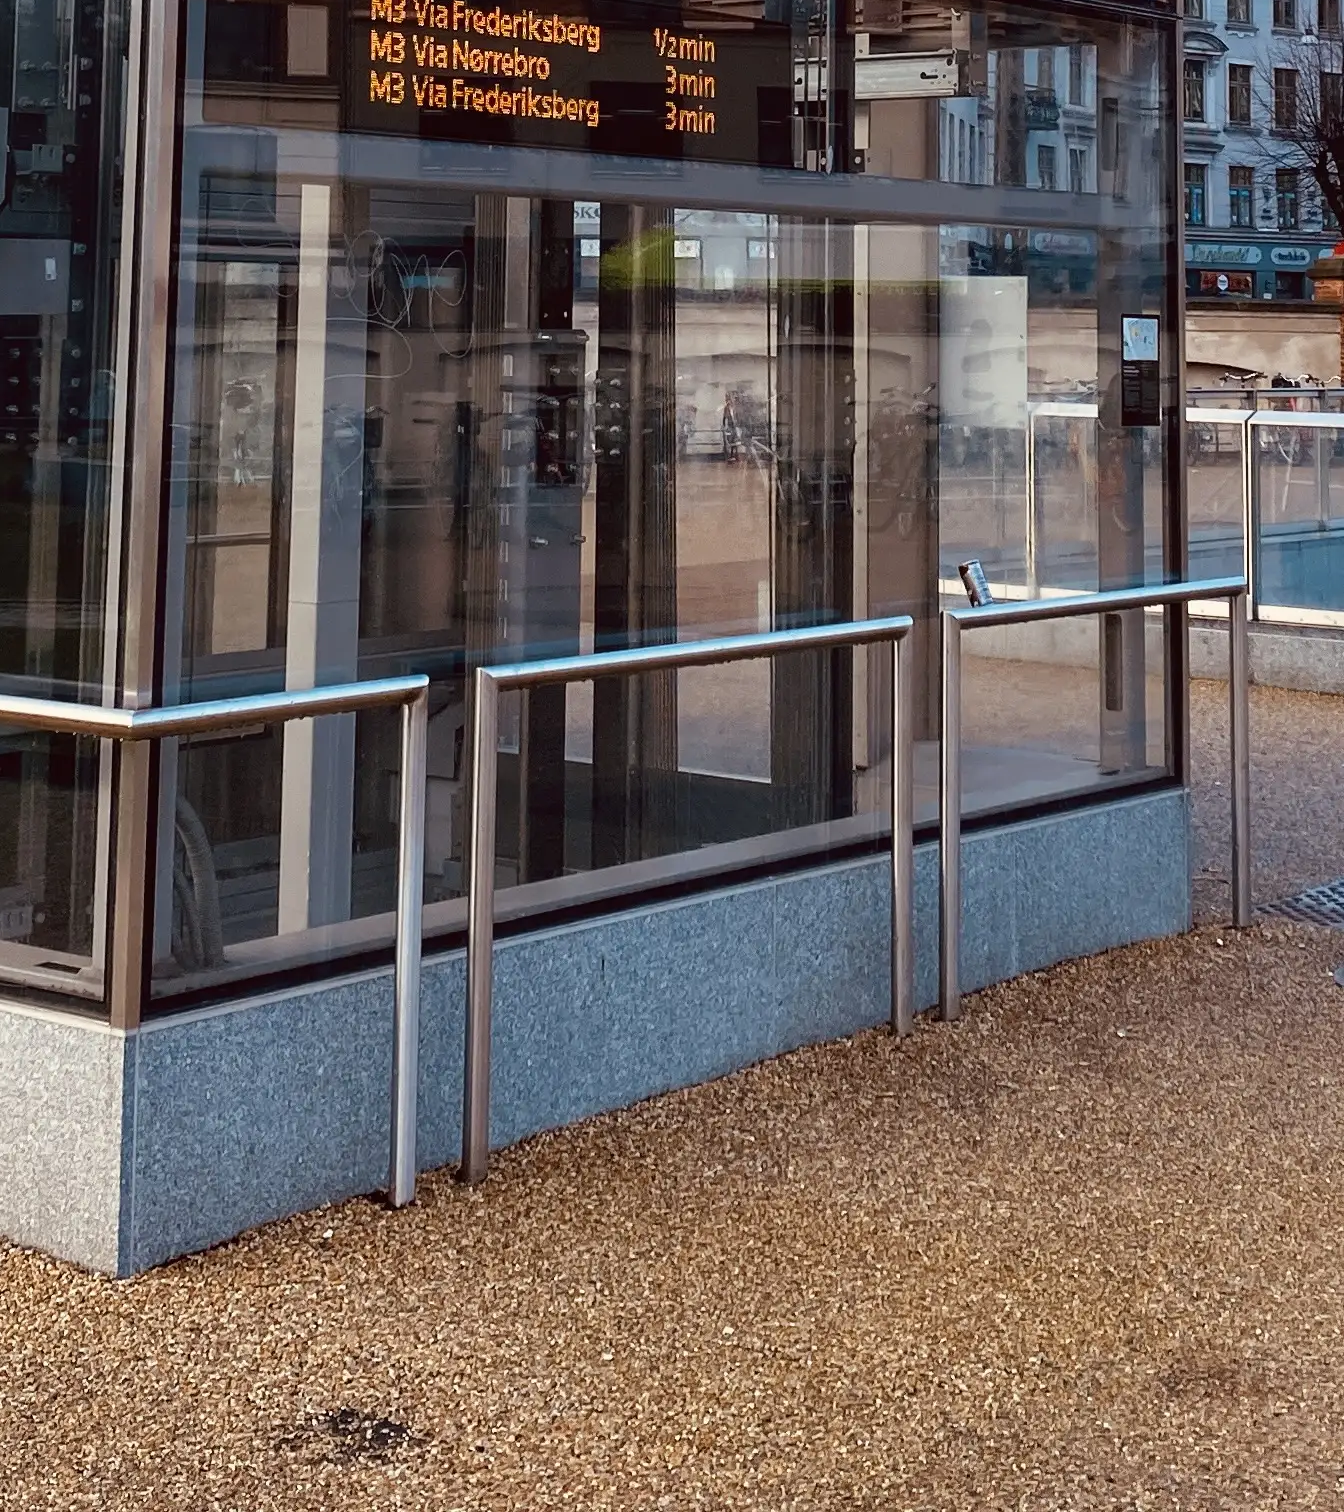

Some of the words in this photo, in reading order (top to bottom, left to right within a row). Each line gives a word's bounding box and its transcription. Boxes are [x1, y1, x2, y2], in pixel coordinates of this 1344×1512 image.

[453, 0, 600, 53] Frederiksberg
[370, 29, 405, 64] M3
[412, 34, 448, 69] Via
[452, 38, 551, 81] Nørrebro
[369, 69, 405, 104] M3
[411, 74, 447, 108] Via
[452, 78, 600, 128] Frederiksberg
